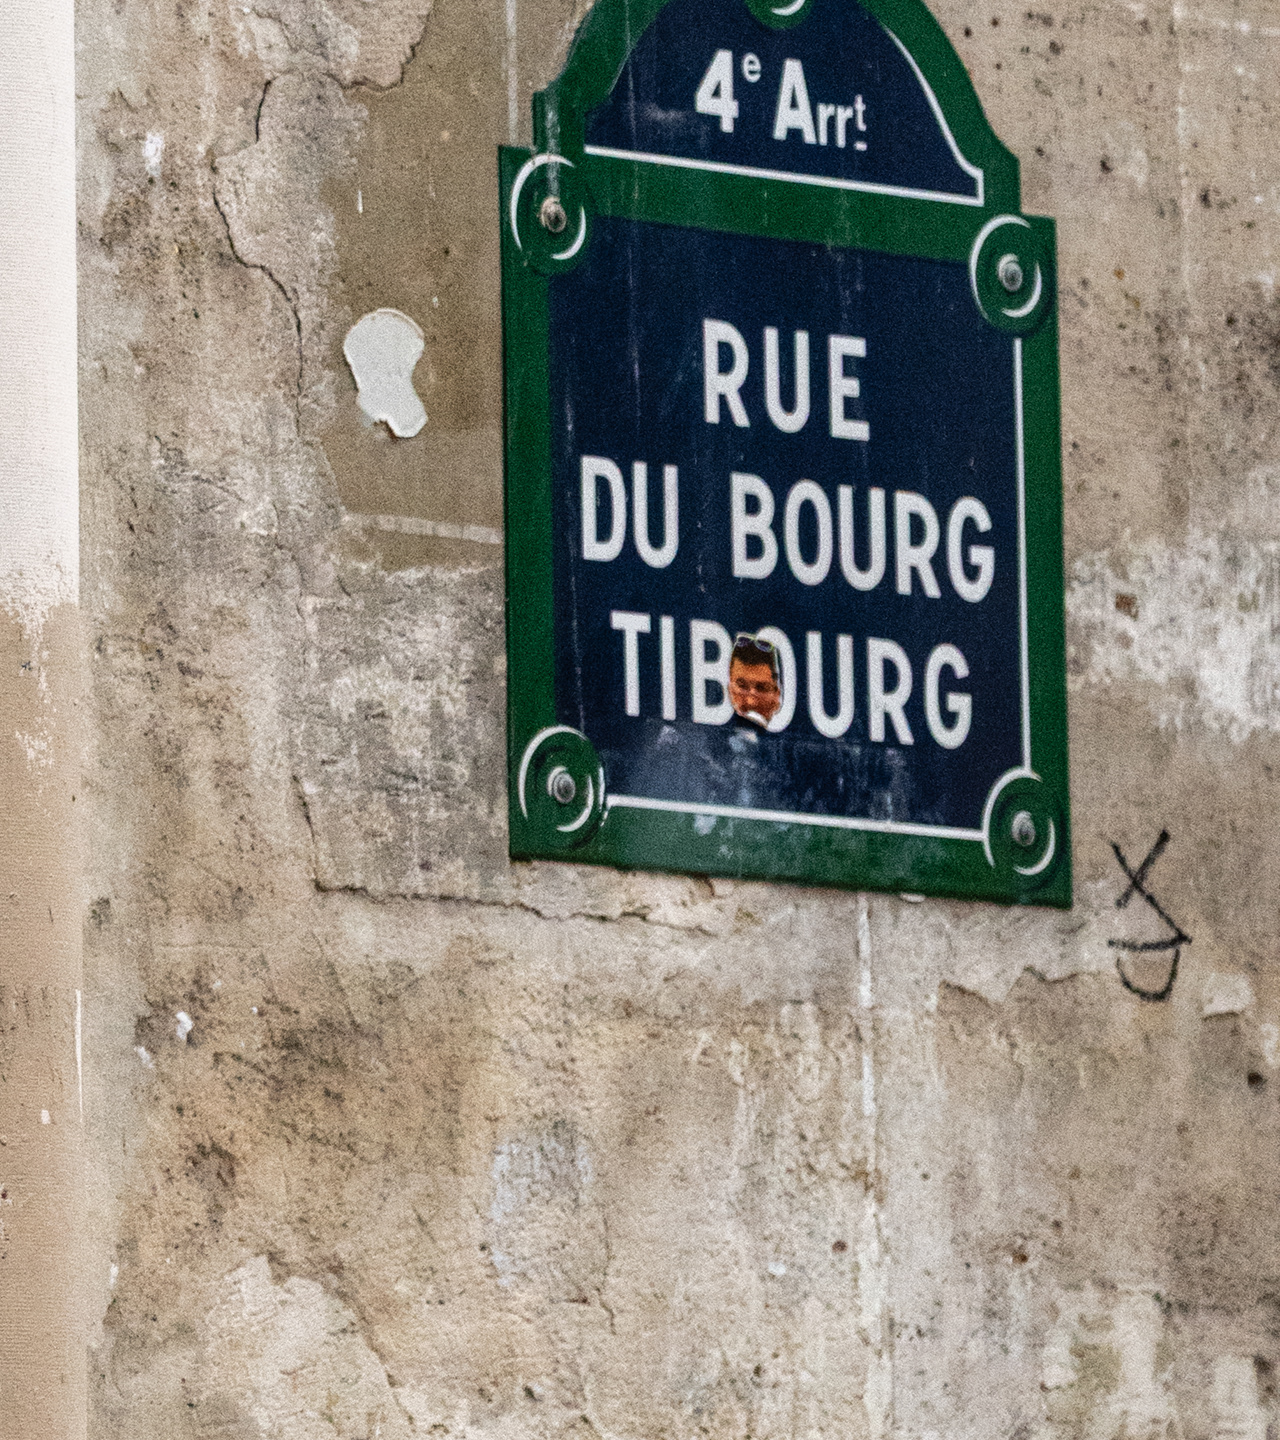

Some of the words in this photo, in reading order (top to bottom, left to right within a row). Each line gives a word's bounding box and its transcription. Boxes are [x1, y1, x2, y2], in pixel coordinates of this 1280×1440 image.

[703, 318, 870, 441] RUE
[581, 455, 679, 569] DU
[731, 472, 995, 604] BOURG
